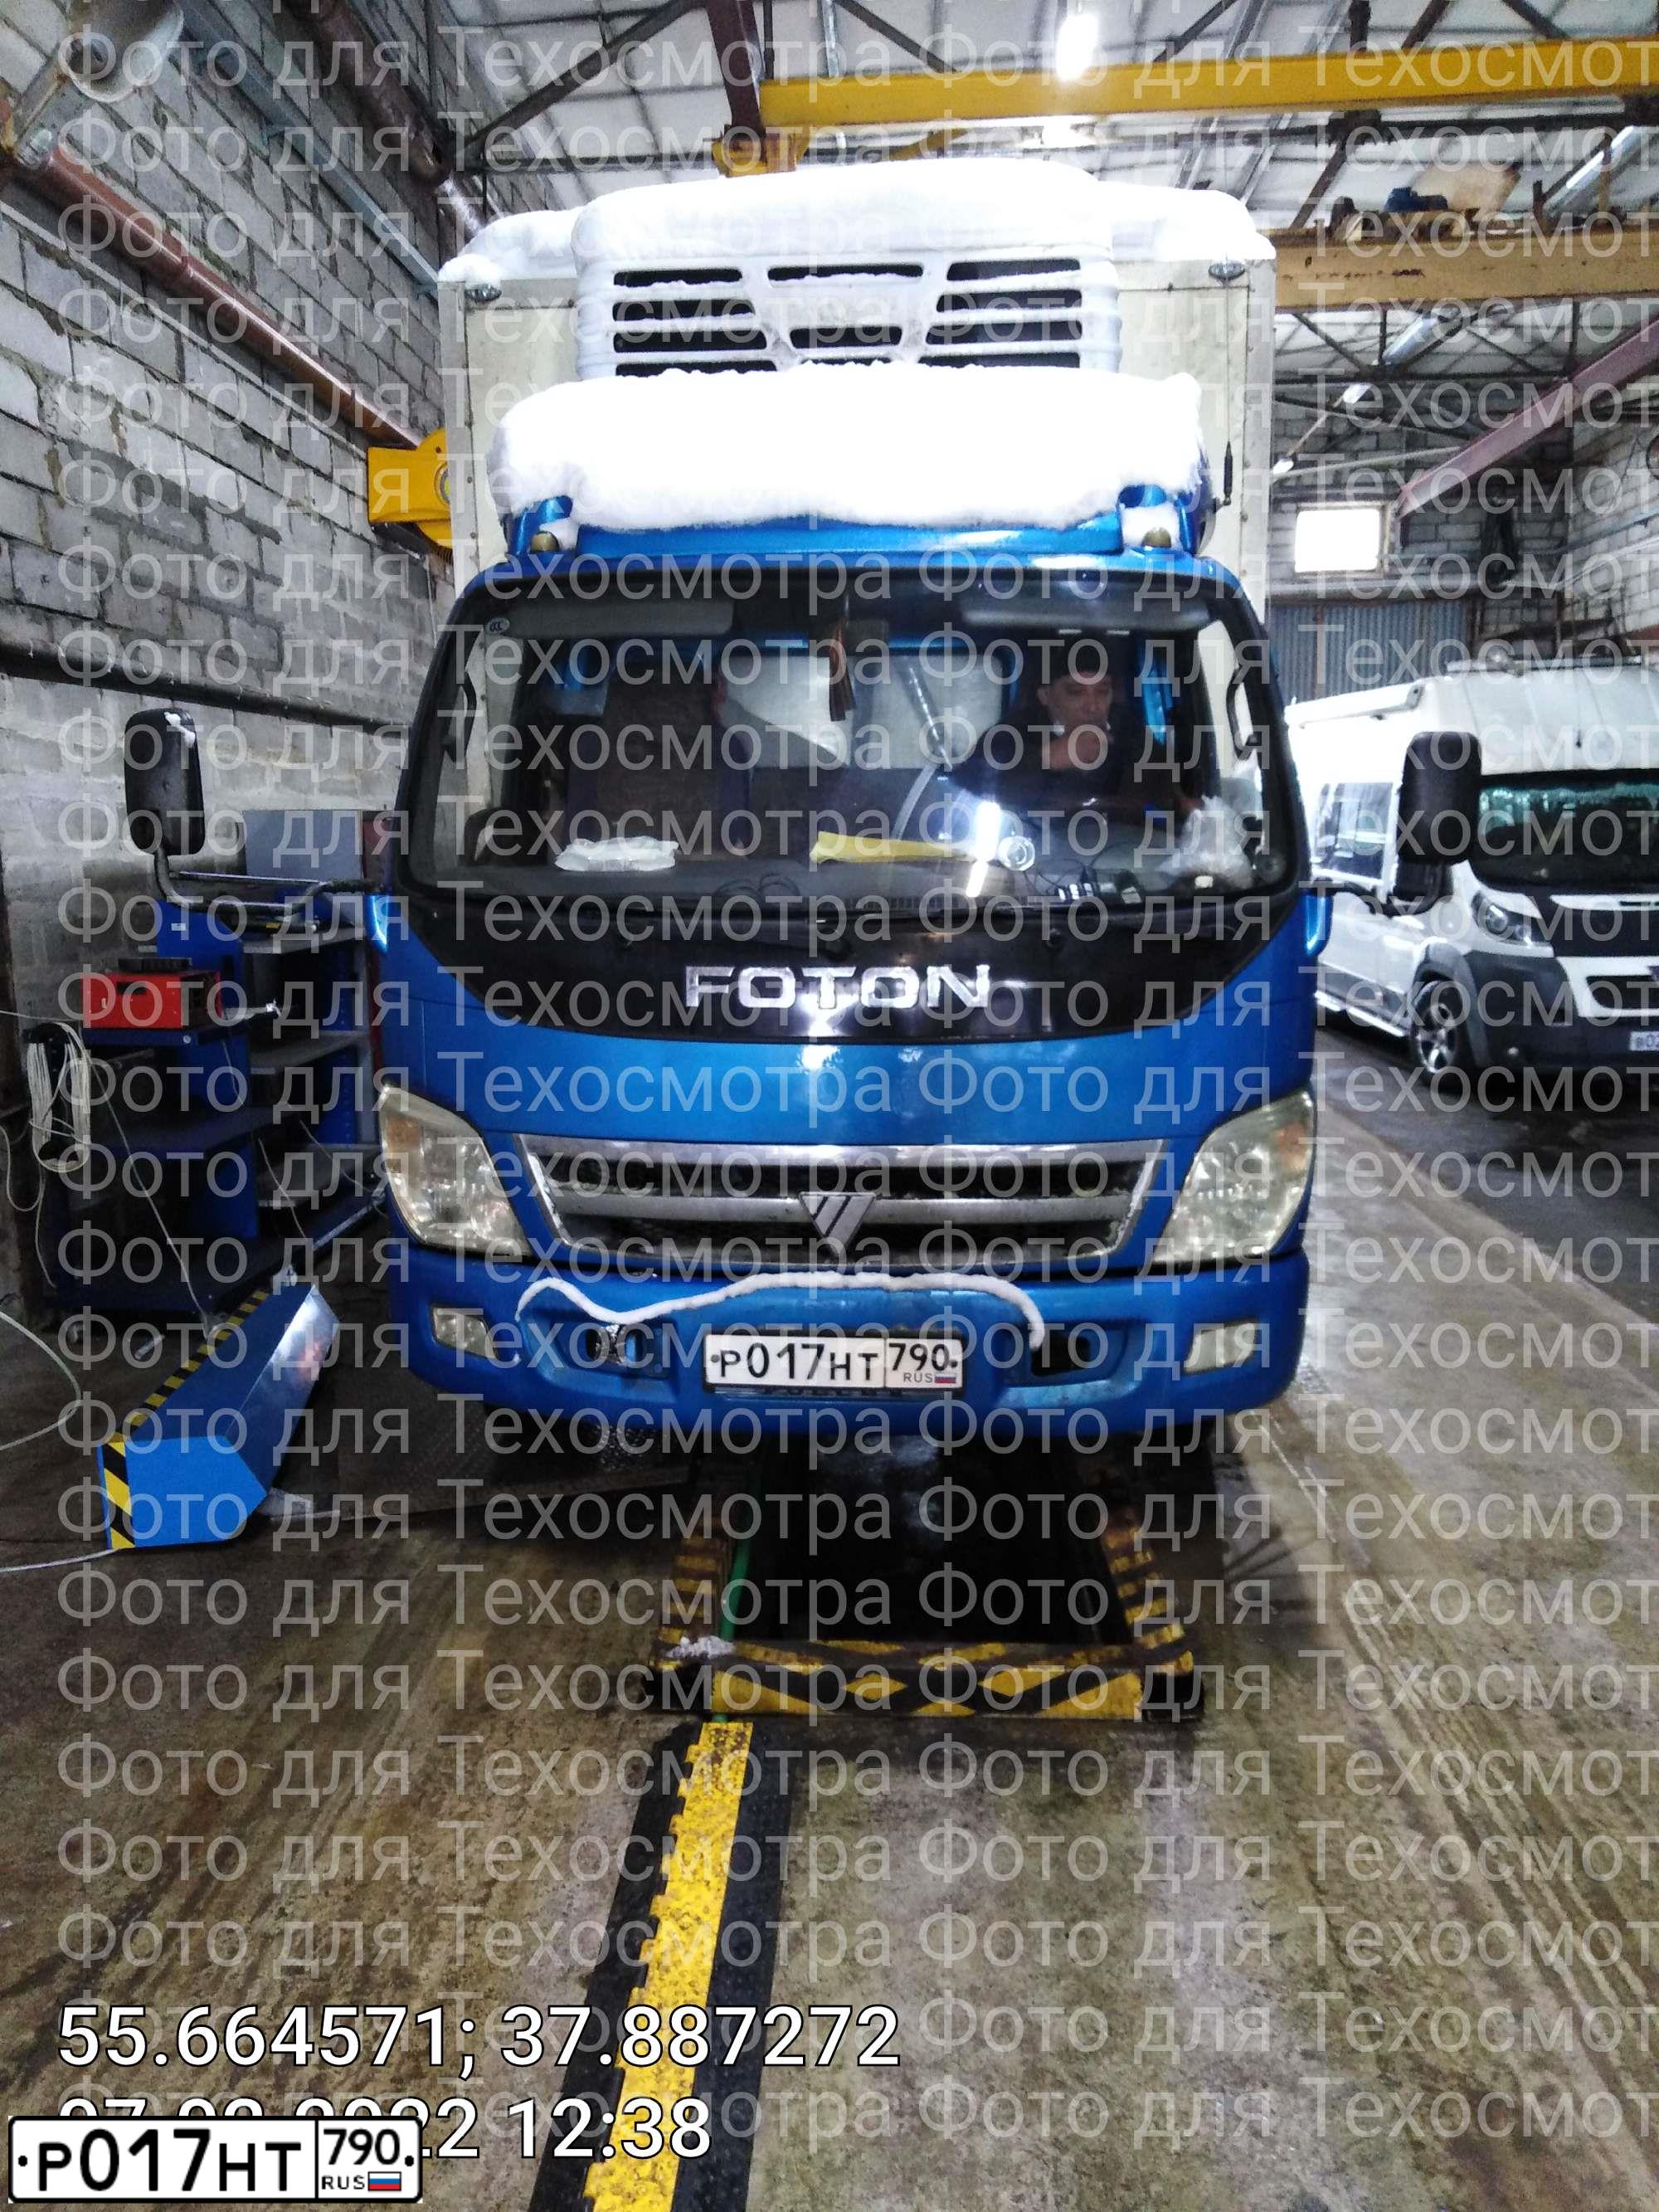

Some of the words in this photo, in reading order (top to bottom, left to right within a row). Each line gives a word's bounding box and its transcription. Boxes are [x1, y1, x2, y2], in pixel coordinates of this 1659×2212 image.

[685, 964, 990, 1010] FOTON
[720, 1342, 878, 1381] Р017НТ
[888, 1342, 950, 1372] 790
[902, 1372, 933, 1383] RUS
